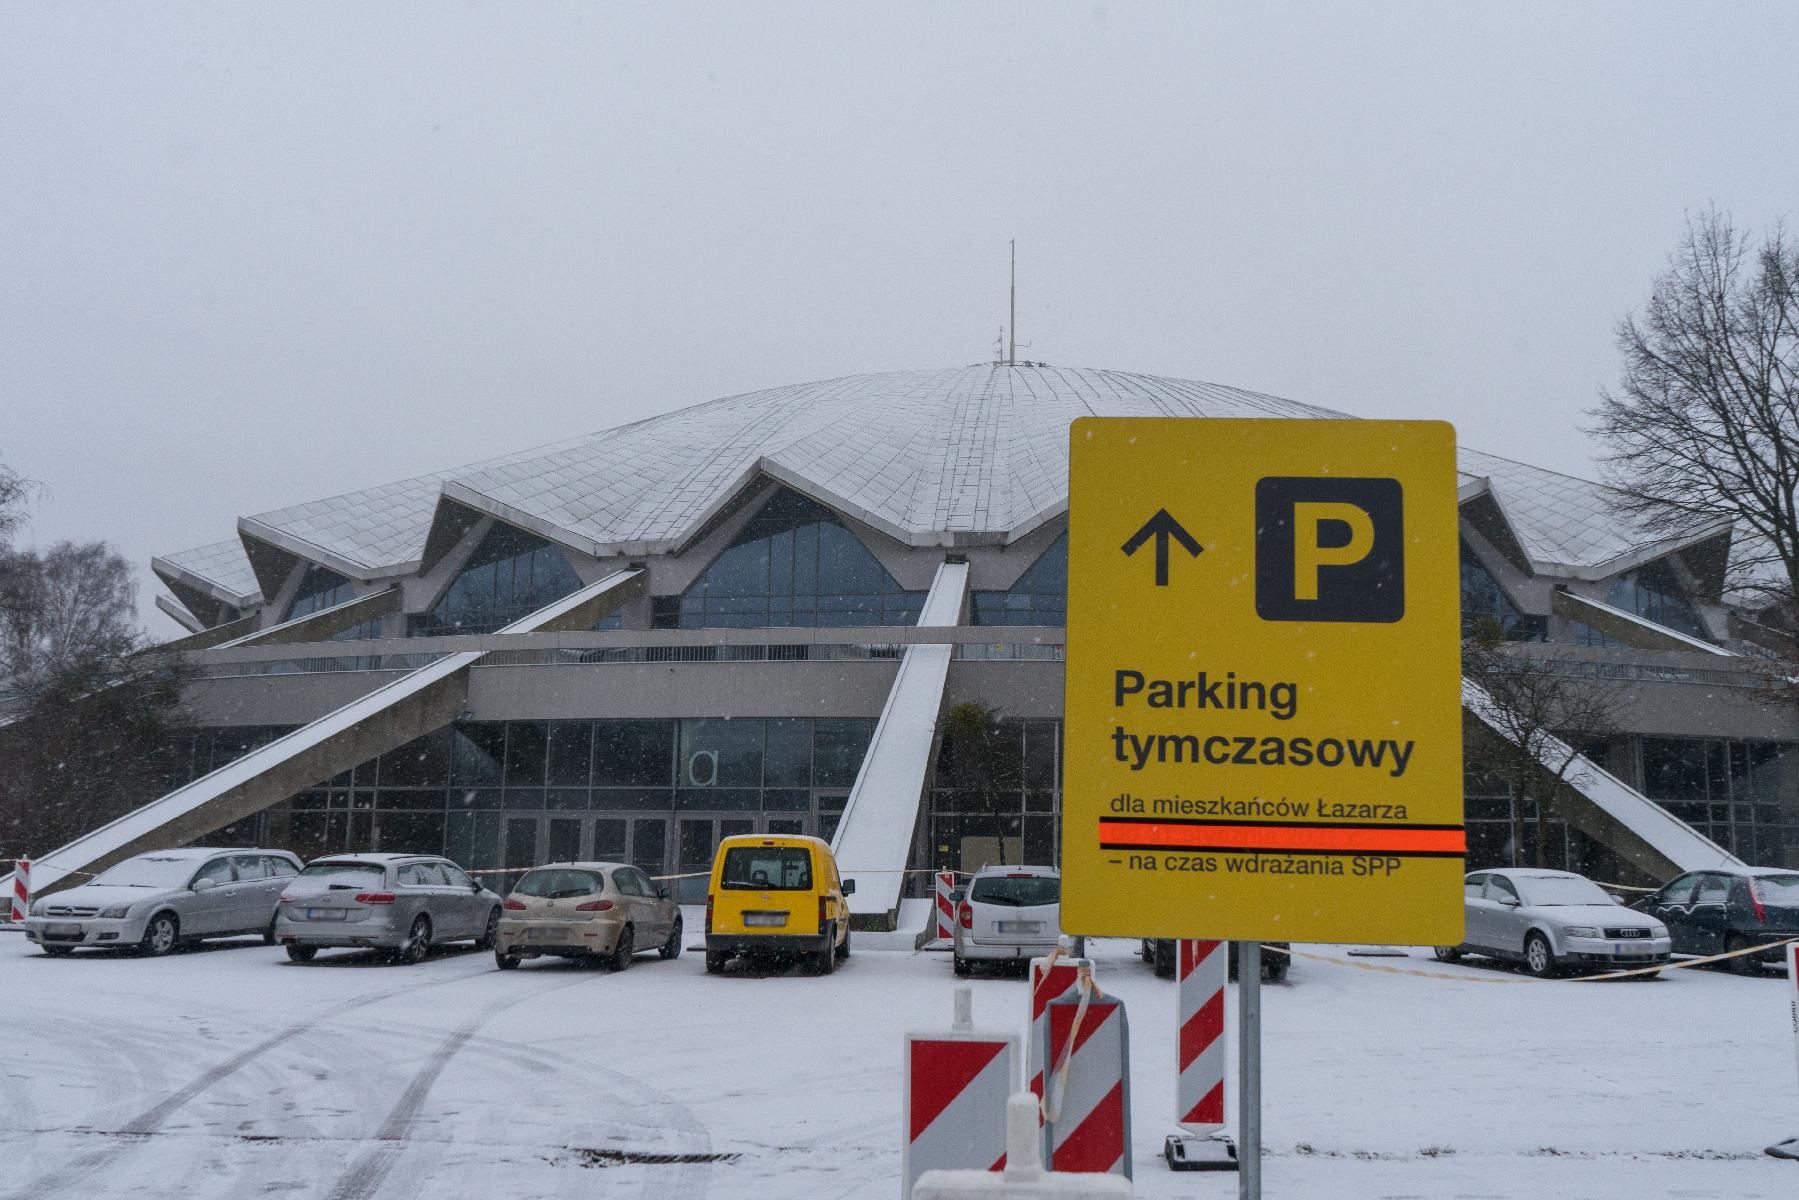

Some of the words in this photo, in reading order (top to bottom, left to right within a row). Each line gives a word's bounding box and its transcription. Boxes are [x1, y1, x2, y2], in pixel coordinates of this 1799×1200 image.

[1294, 502, 1375, 601] P
[1115, 670, 1299, 720] Parking
[1111, 726, 1415, 777] tymczasowy
[1110, 793, 1145, 814] dla
[1152, 795, 1310, 818] mieszkańców
[1317, 798, 1408, 820] Łazarza
[1129, 855, 1157, 871] na
[1164, 855, 1217, 872] czas
[1225, 854, 1344, 875] wdrażania
[1351, 856, 1401, 876] SPP
